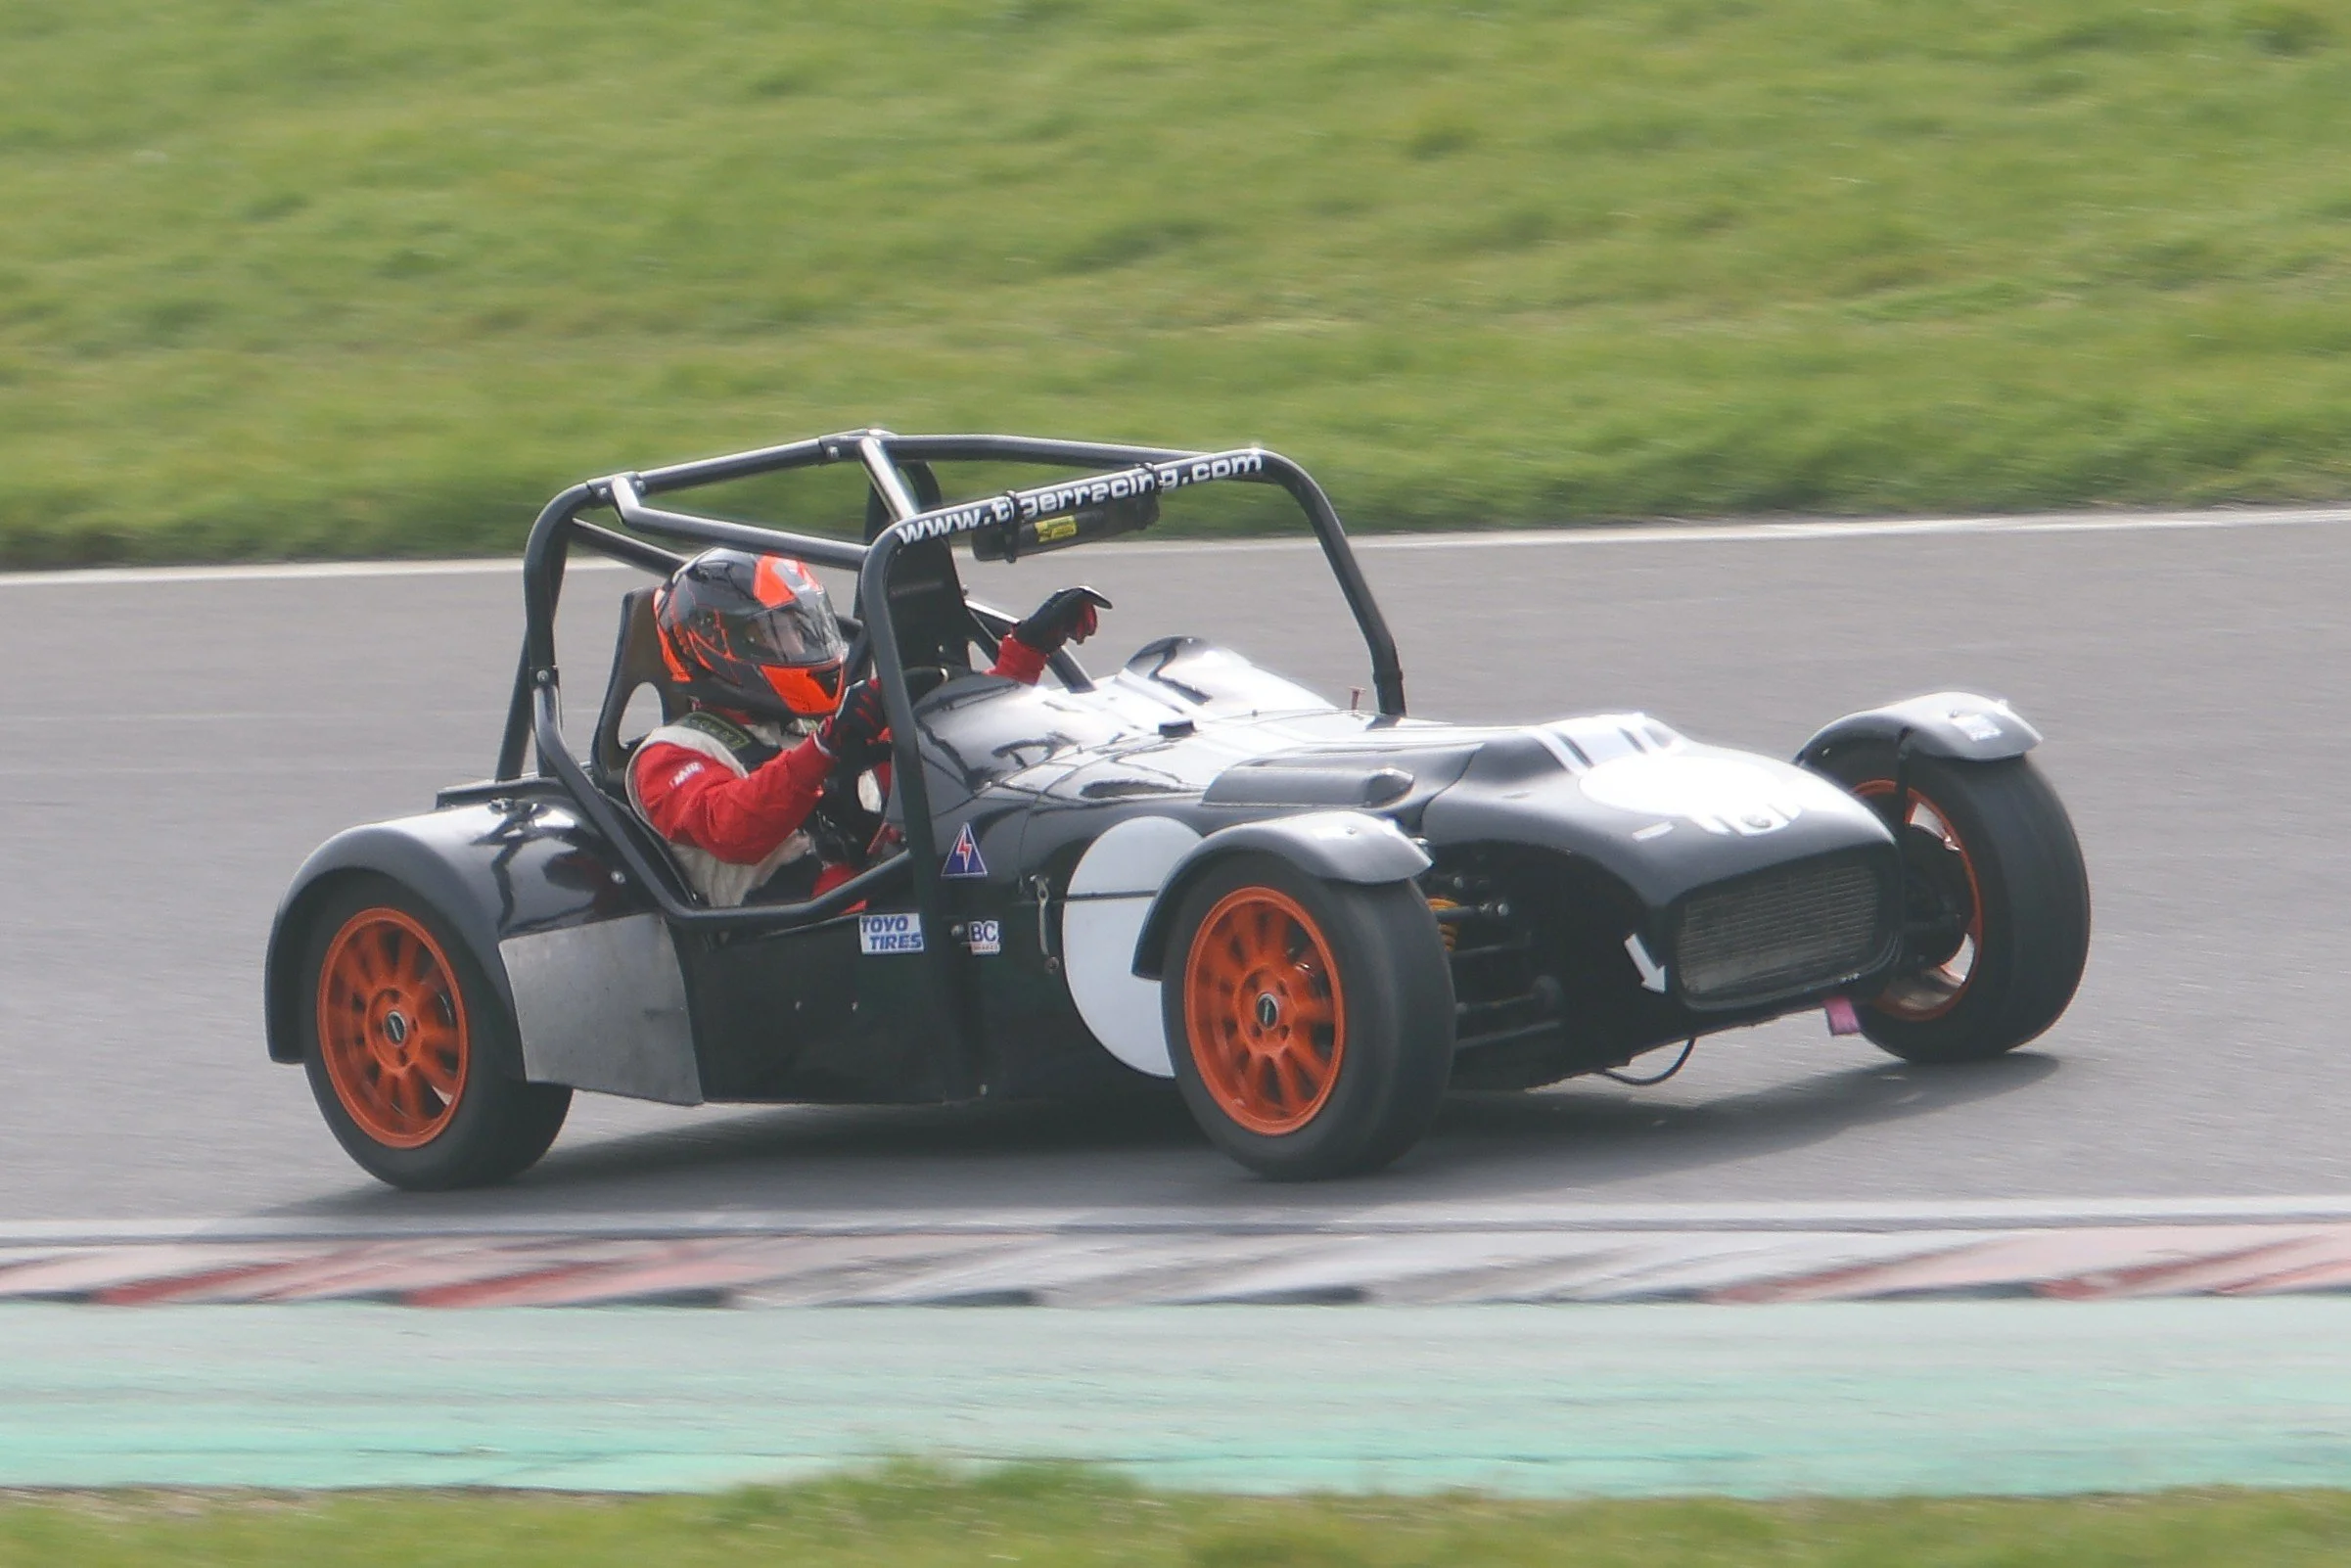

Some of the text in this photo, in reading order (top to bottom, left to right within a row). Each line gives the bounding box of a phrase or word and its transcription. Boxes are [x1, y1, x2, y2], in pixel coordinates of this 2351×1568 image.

[860, 915, 908, 932] TOYO
[971, 922, 997, 942] BC
[869, 932, 922, 950] TIRES
